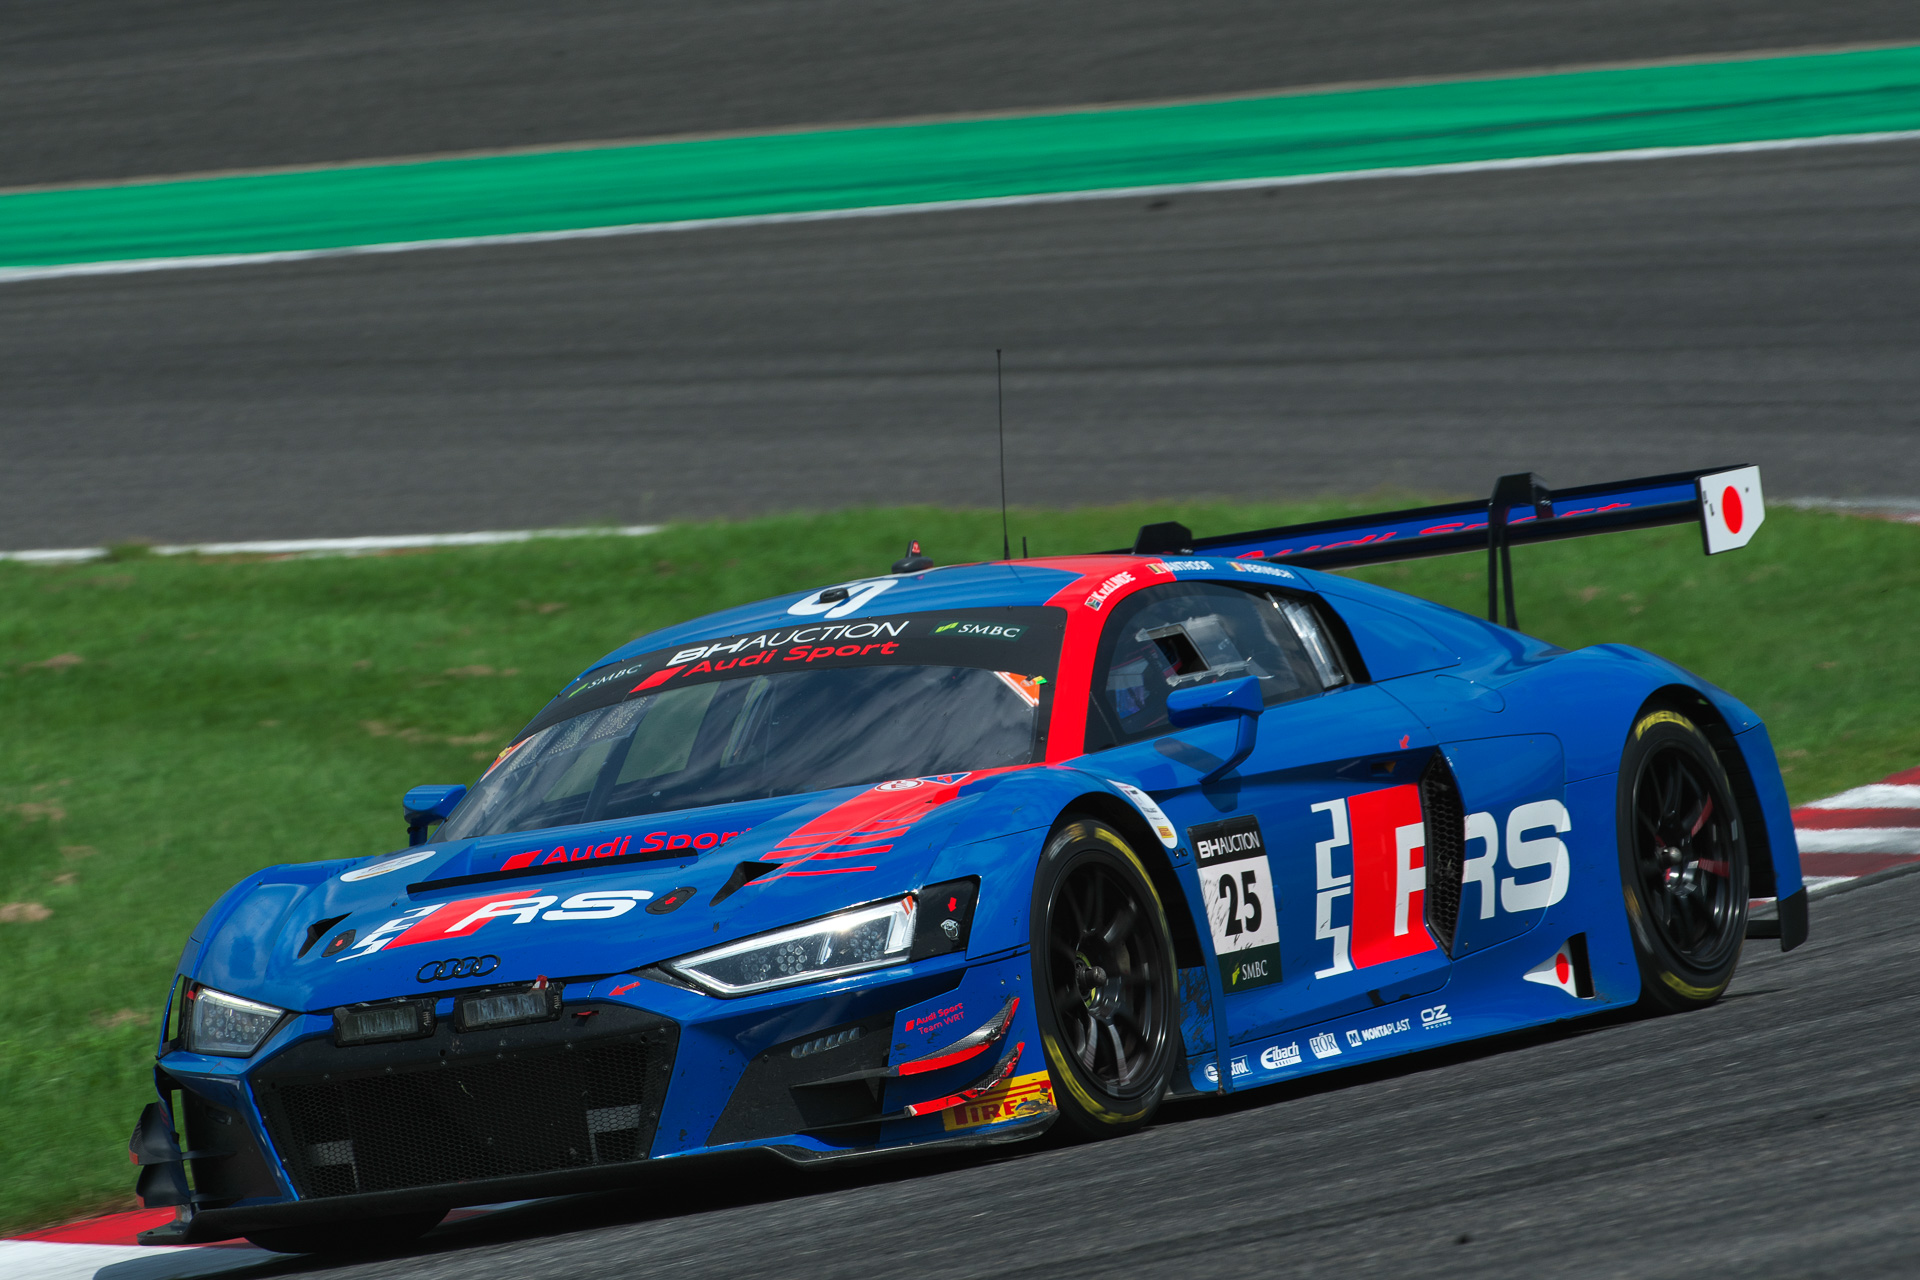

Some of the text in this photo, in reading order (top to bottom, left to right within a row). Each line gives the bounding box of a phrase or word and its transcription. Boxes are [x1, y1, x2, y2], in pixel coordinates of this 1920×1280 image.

[957, 623, 1021, 638] SMBC
[682, 641, 900, 678] Audi Sport
[587, 663, 642, 689] SMBC
[541, 827, 752, 866] Audi Spor
[1218, 870, 1263, 937] 25
[1241, 959, 1269, 981] SMBC
[916, 1002, 964, 1026] Audi Sport
[917, 1011, 965, 1035] Team WRT
[1361, 1018, 1411, 1041] MONTAPLAST
[1260, 1041, 1301, 1069] Eibach
[1310, 1032, 1339, 1055] HÖR
